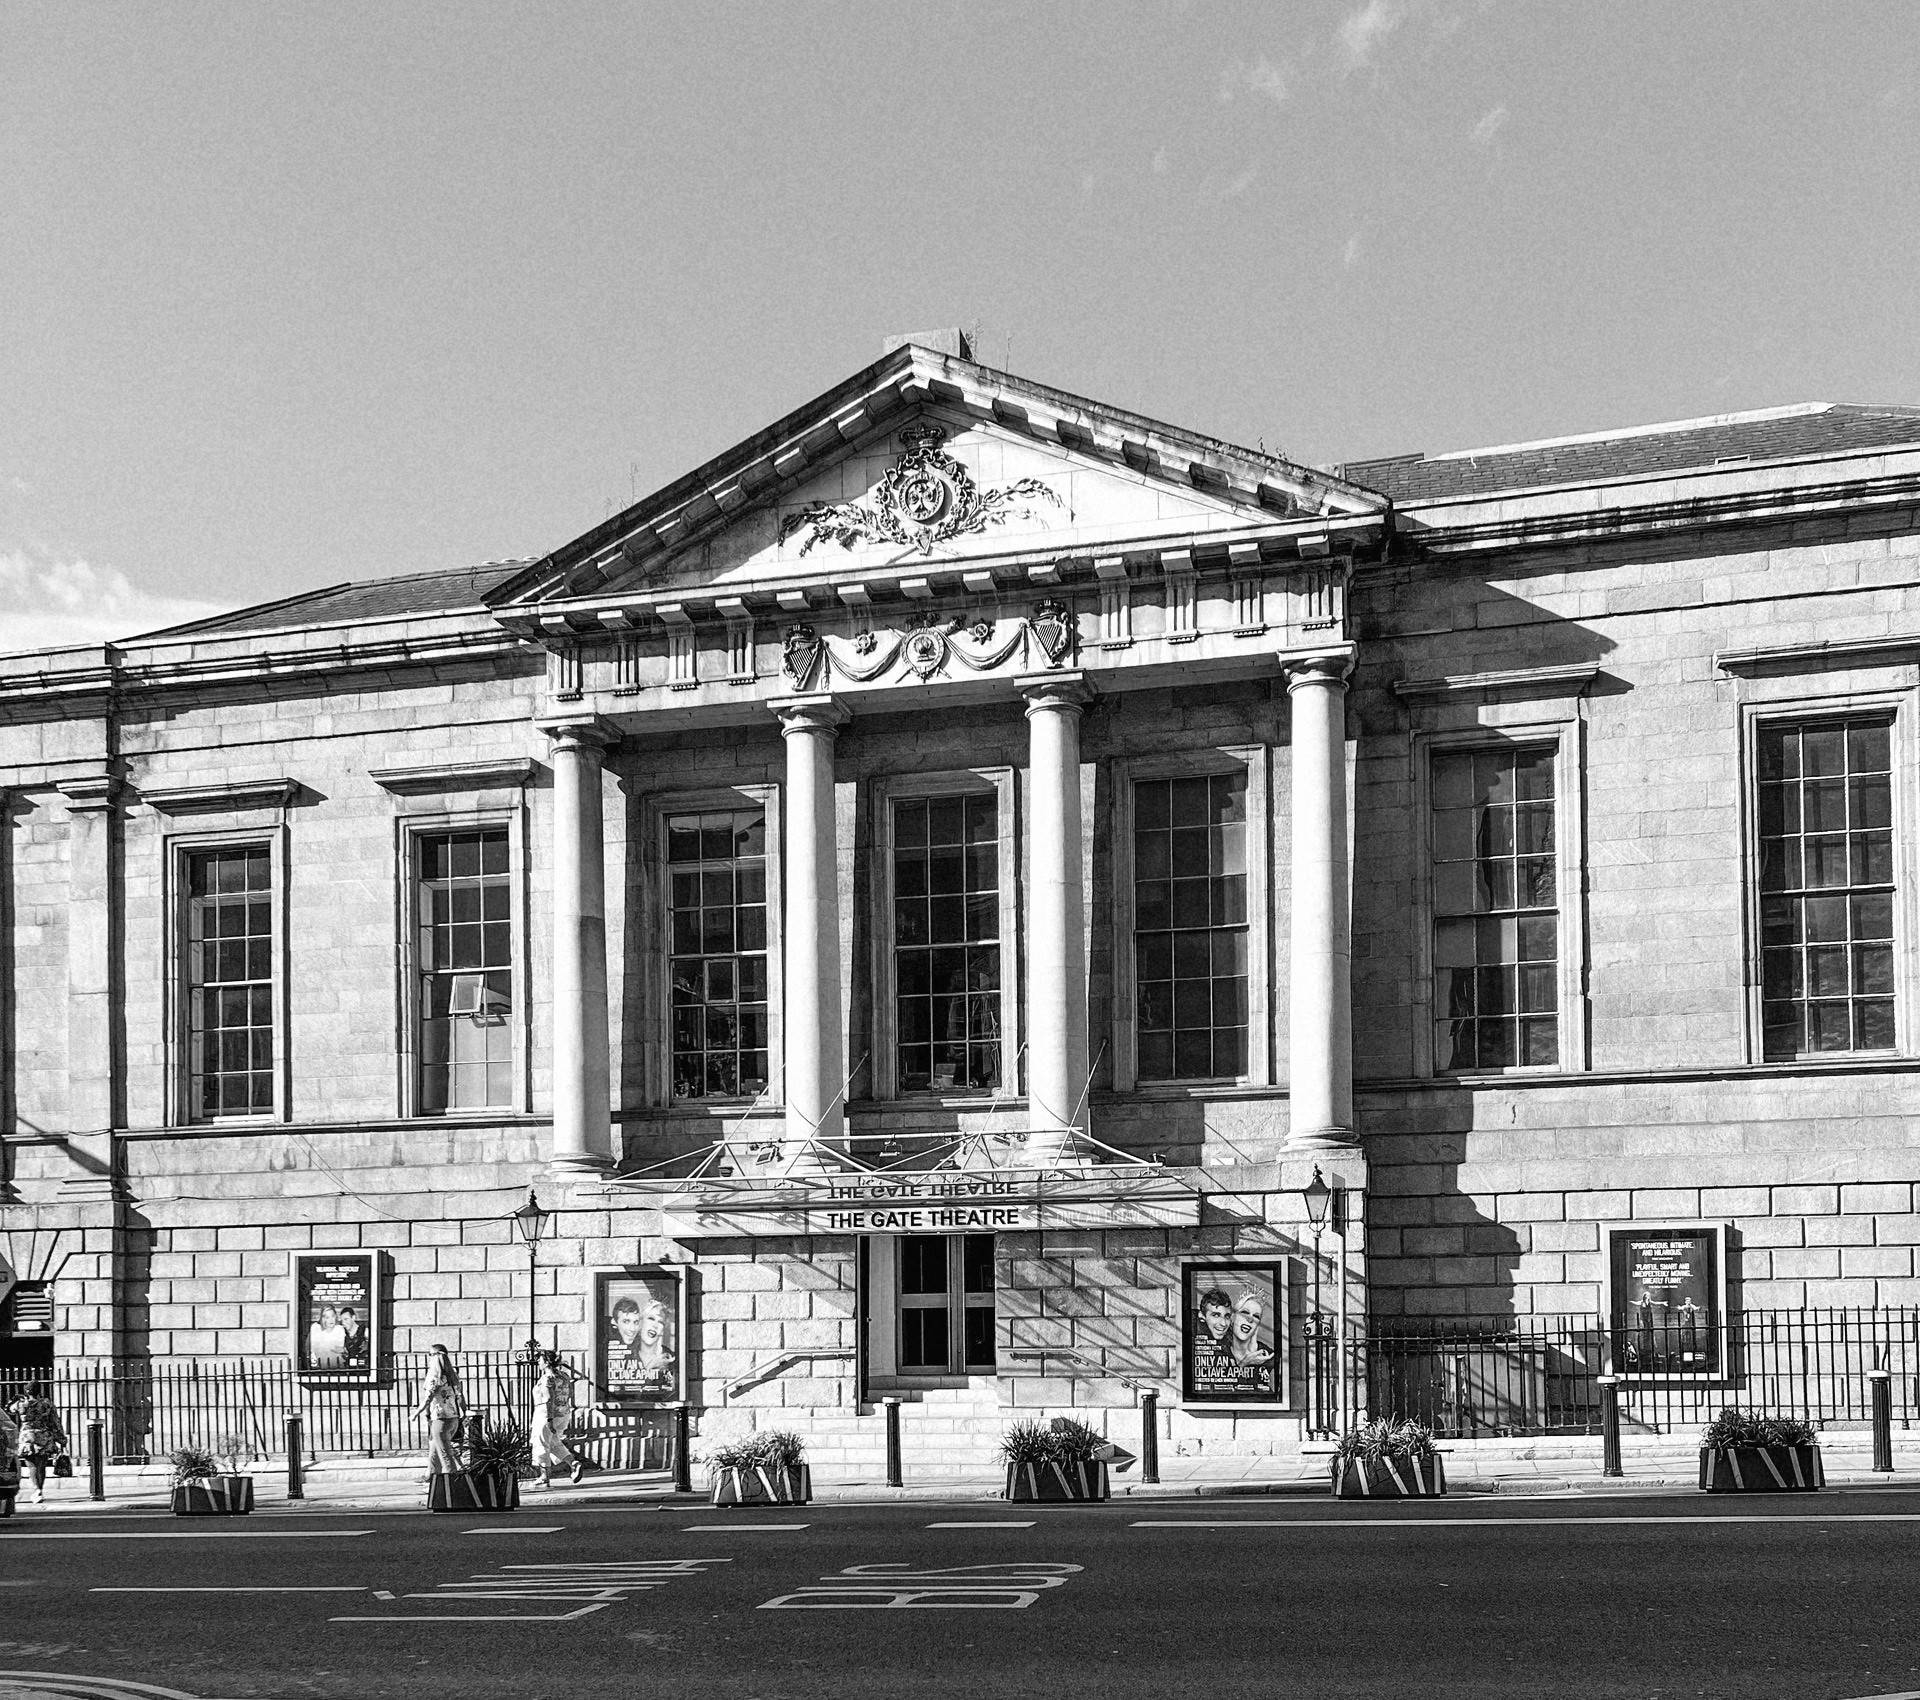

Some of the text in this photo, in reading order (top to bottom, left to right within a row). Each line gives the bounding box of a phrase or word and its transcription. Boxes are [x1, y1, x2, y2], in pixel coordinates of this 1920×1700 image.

[827, 1208, 1019, 1229] THE GATE THEATRE
[607, 1360, 638, 1370] ONLY AN
[1194, 1356, 1229, 1367] ONLY AN
[607, 1369, 636, 1380] OCTAVE
[635, 1369, 660, 1380] APART
[1194, 1367, 1227, 1378] OCTAVE
[1227, 1367, 1255, 1378] APART
[755, 1562, 1085, 1609] BUS
